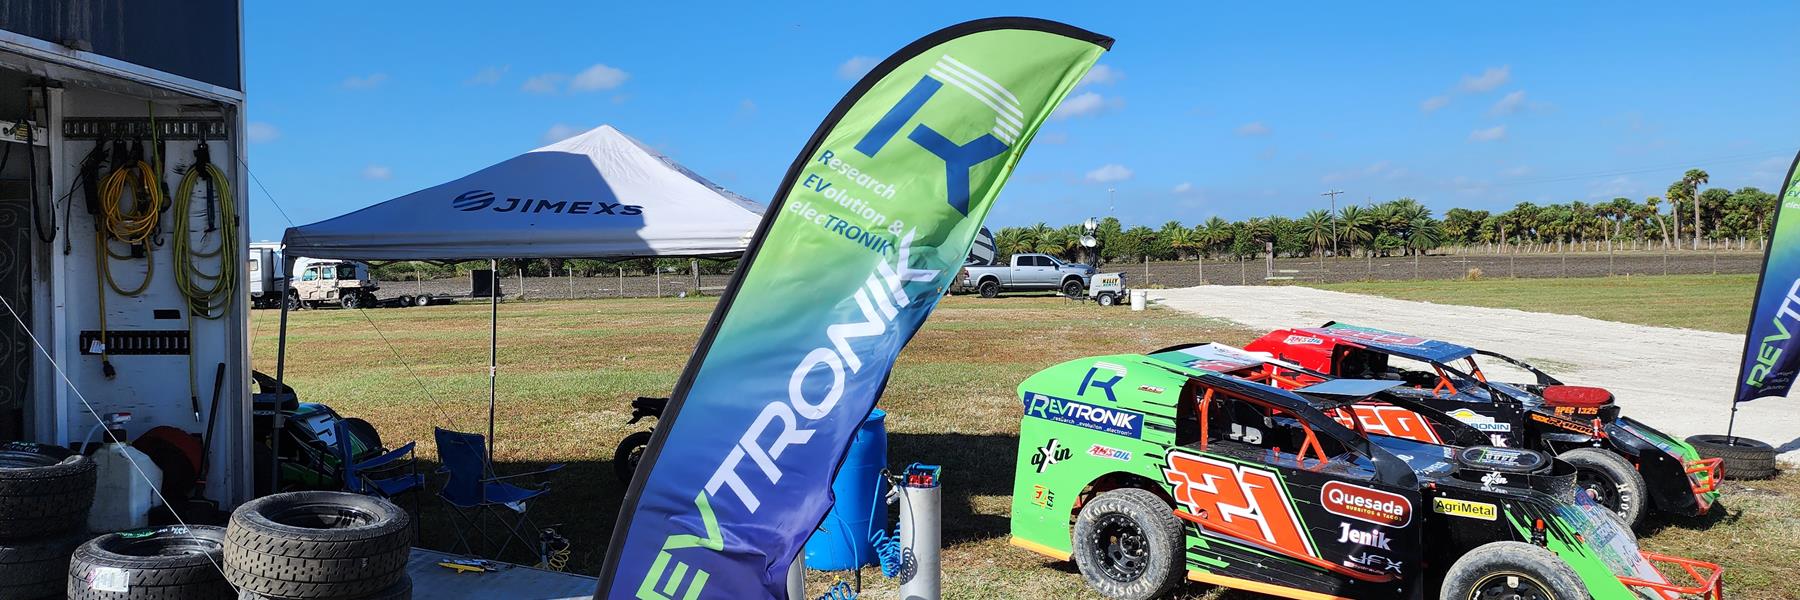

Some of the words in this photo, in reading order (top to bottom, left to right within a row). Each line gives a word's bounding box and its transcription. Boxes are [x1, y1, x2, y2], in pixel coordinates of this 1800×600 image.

[817, 149, 897, 199] Research
[493, 197, 645, 216] JIMEXS
[803, 173, 887, 226] EVolution
[887, 219, 905, 237] &
[790, 199, 897, 256] elecTRONIK
[1028, 394, 1137, 430] REVTRONIK
[1555, 406, 1576, 414] SPEC
[1089, 445, 1130, 461] AMSOIL
[1328, 488, 1404, 516] Quesada
[1435, 501, 1495, 517] AgriMetal
[1337, 521, 1392, 551] Jenik
